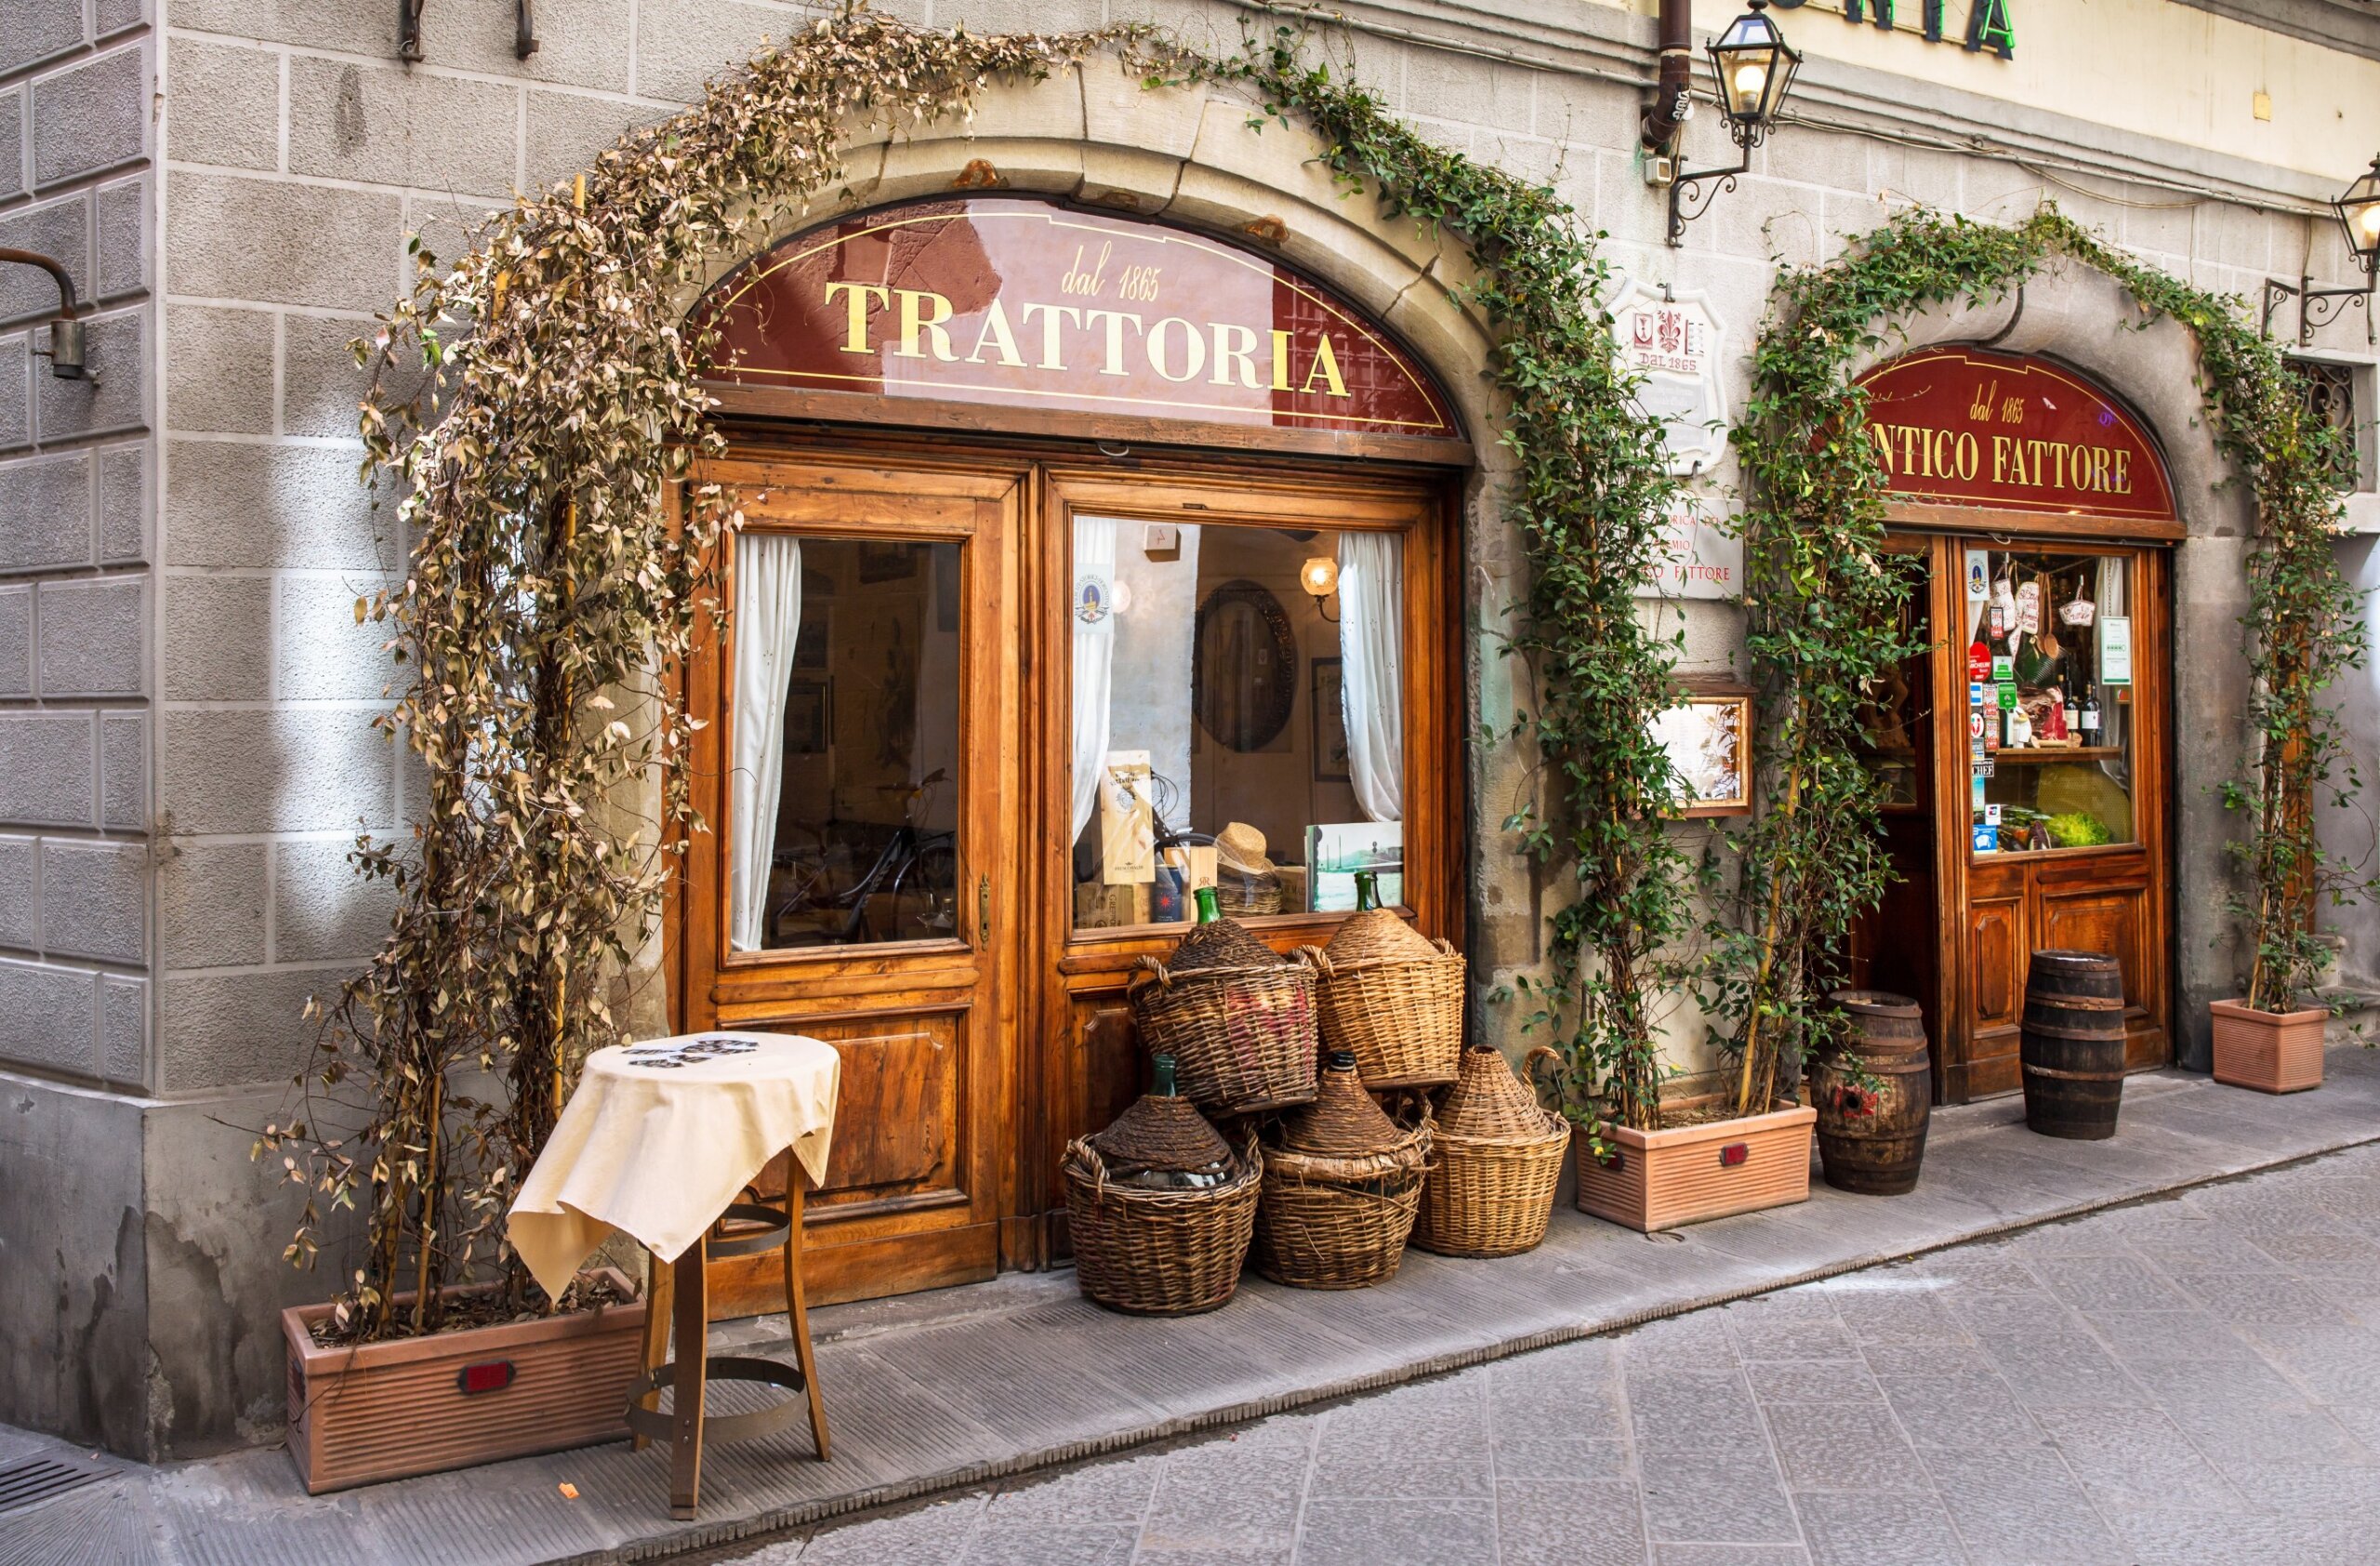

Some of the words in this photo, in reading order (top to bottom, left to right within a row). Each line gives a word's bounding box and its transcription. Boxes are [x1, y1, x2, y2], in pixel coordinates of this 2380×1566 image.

[1062, 240, 1112, 297] dal
[1119, 266, 1159, 303] 1865
[825, 281, 1353, 398] TRATTORIA
[1668, 357, 1697, 371] 1865
[1969, 380, 1998, 422] dal
[2002, 396, 2025, 425] 1865
[1871, 422, 1979, 482] NTICO
[1991, 435, 2133, 495] FATTORE
[1654, 539, 1690, 551] EMIO
[1674, 564, 1730, 580] FTTORE
